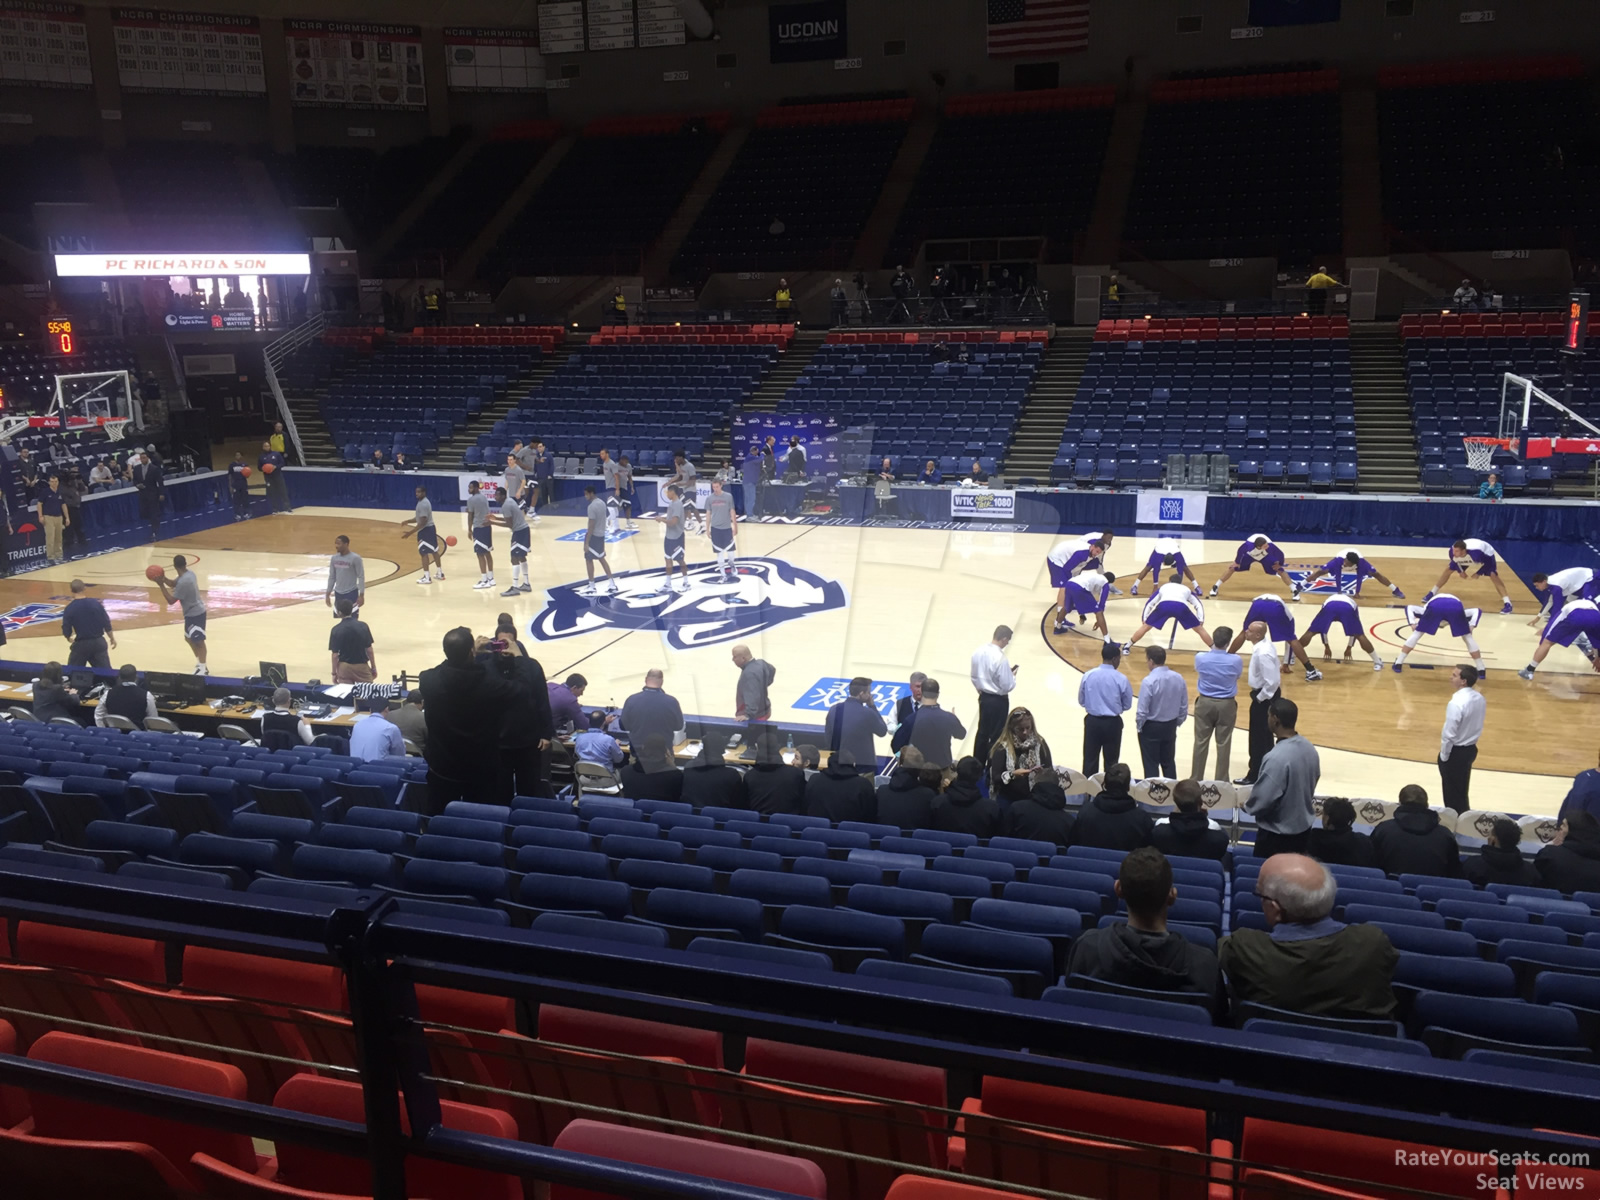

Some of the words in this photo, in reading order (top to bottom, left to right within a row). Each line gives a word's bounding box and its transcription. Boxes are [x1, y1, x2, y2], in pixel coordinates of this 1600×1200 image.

[0, 0, 76, 13] MPIONSHIP
[120, 10, 154, 21] NCAA
[159, 12, 252, 26] CHAMPIONSHIP
[291, 21, 323, 30] NCAA
[328, 23, 414, 34] CHAMPIONSHIP
[445, 28, 472, 36] NCAA
[477, 29, 538, 38] CHAMPIONS
[778, 19, 838, 38] UCONN
[1245, 28, 1263, 37] 210
[846, 59, 861, 67] 208
[105, 259, 128, 270] PC
[133, 259, 216, 270] RICHARD
[218, 259, 229, 269] &
[234, 259, 267, 269] SON
[48, 322, 71, 333] 55:48
[61, 334, 71, 352] 0
[955, 496, 974, 506] WTIC
[993, 497, 1012, 507] 1080
[1161, 505, 1182, 513] YORK
[7, 545, 47, 560] TRAVELE
